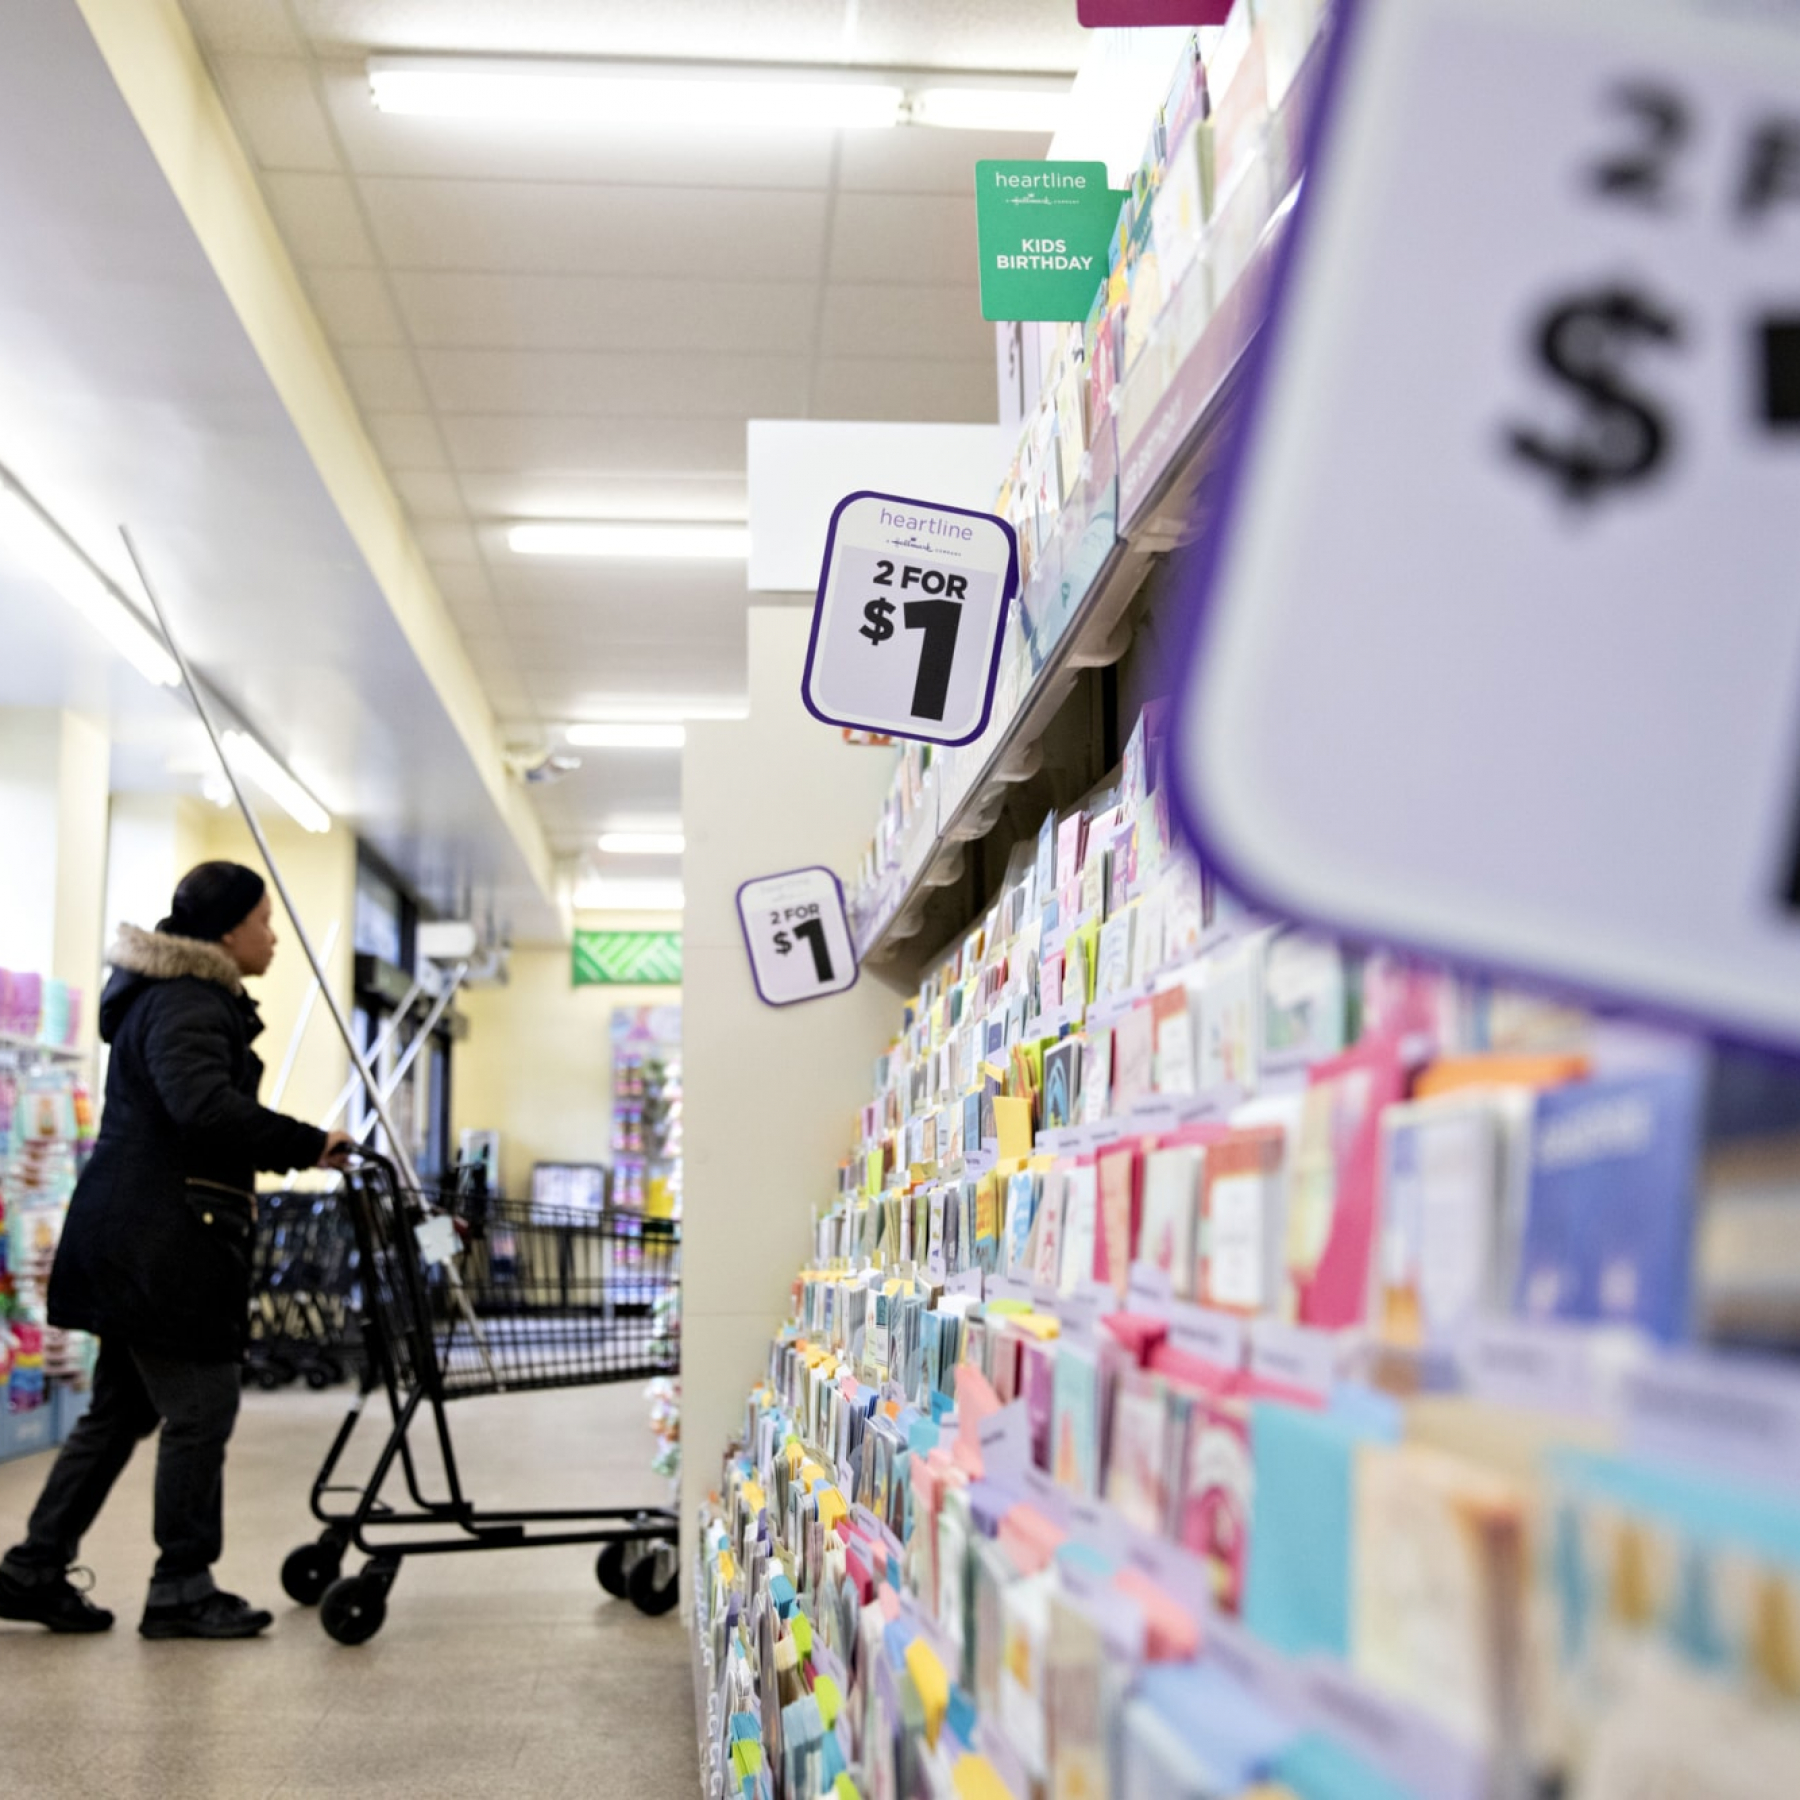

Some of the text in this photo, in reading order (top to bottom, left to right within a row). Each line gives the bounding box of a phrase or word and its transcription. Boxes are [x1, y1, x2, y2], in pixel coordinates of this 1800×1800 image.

[1589, 76, 1694, 209] 2
[995, 172, 1086, 188] heartline
[996, 255, 1093, 270] BIRTHDAY
[1021, 239, 1067, 253] KIDS
[880, 508, 973, 541] heartline
[873, 560, 968, 600] 2 FOR
[858, 597, 963, 722] $1
[770, 903, 820, 925] 2 FOR
[772, 918, 835, 983] $1
